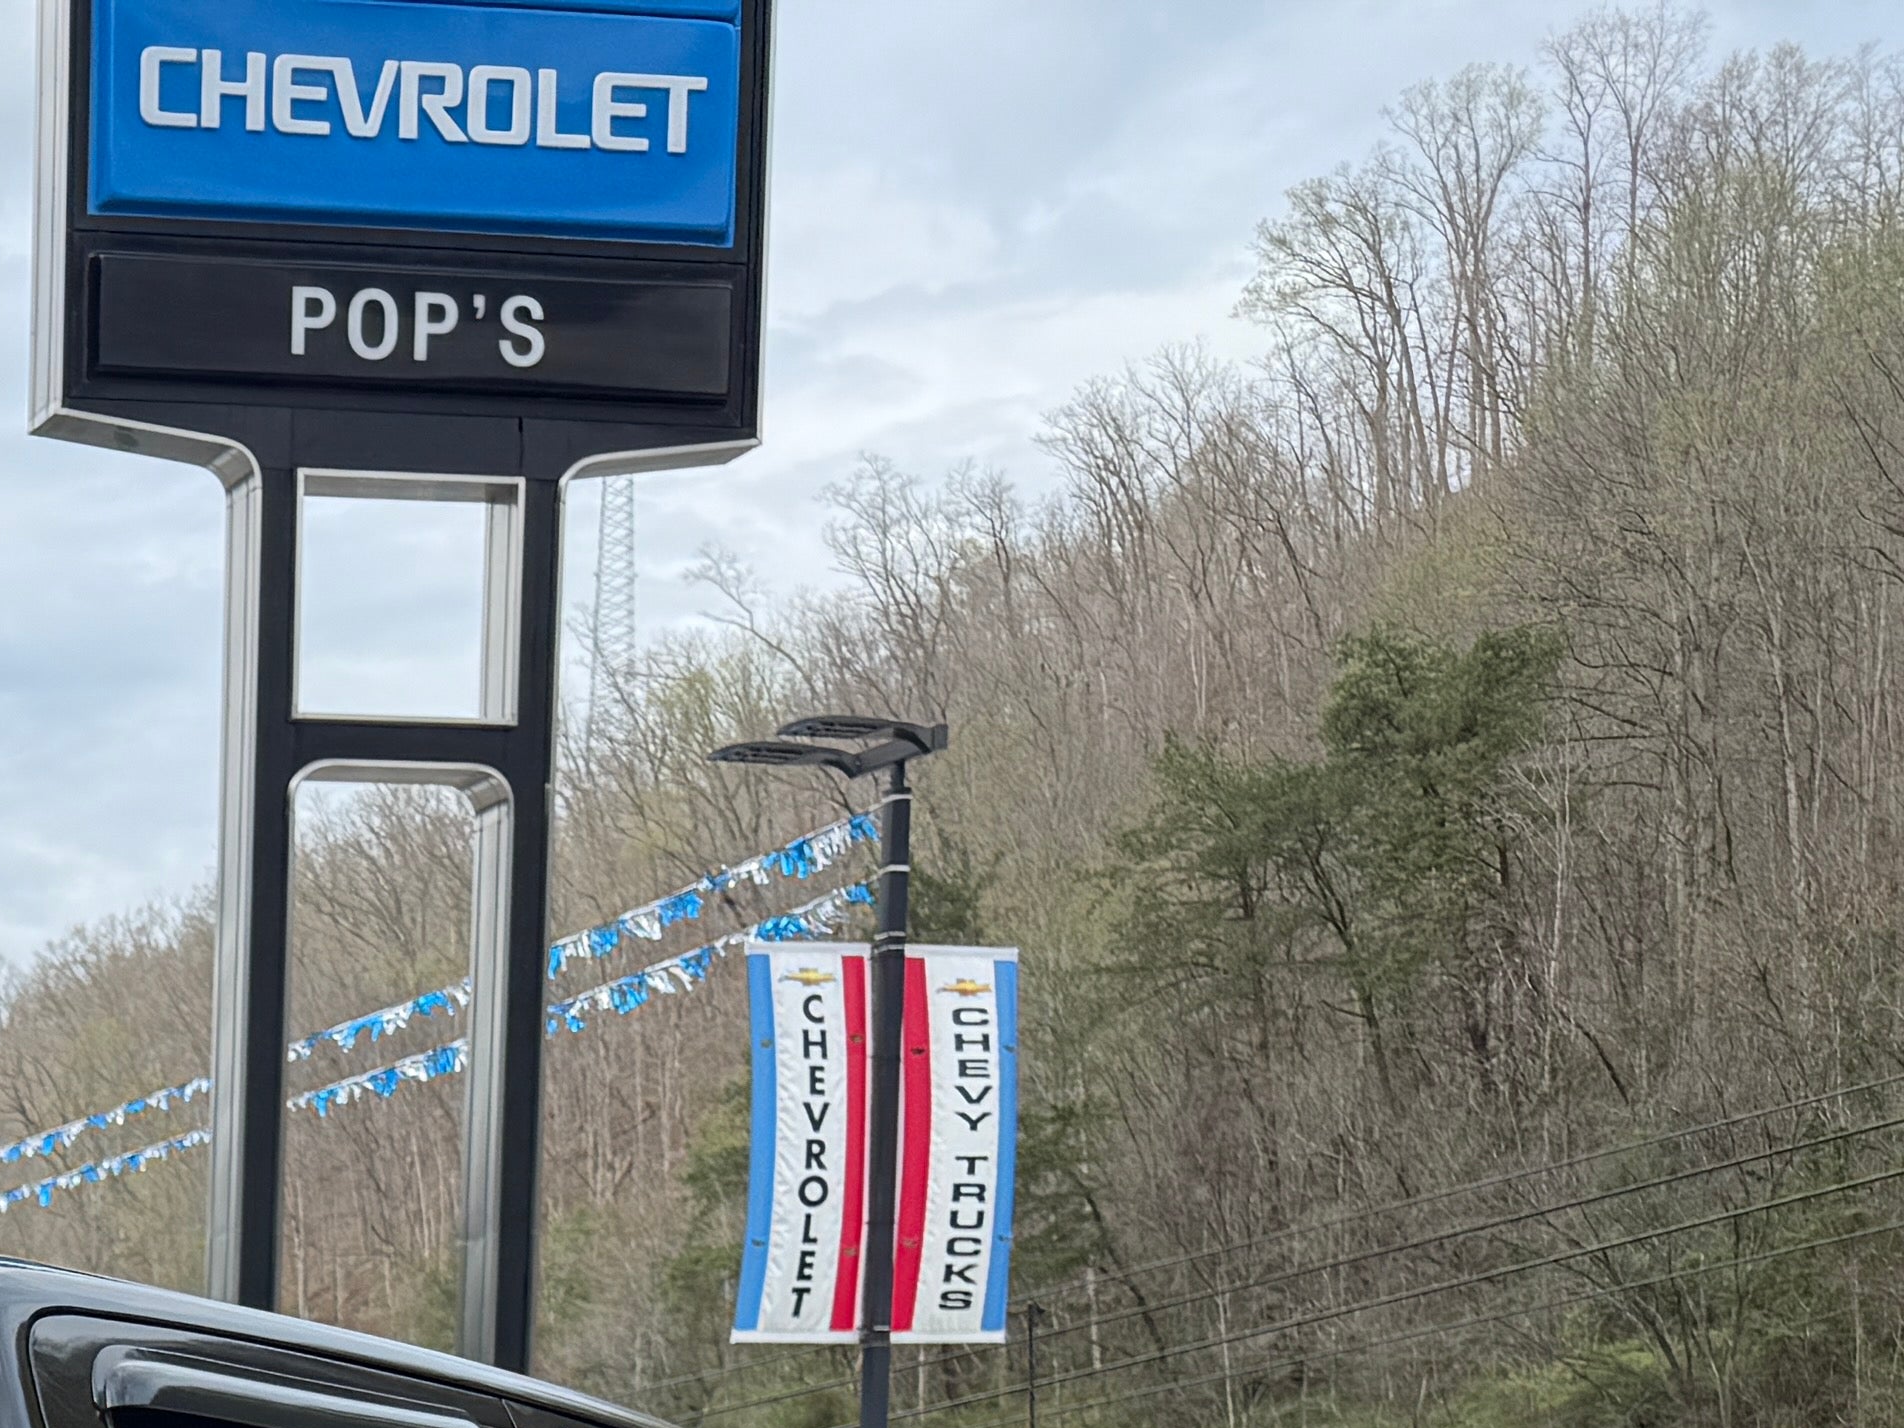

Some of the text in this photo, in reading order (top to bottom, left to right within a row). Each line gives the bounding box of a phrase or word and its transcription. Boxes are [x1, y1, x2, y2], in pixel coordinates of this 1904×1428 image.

[138, 45, 708, 155] CHEVROLET
[290, 285, 547, 368] POP'S
[791, 994, 830, 1319] CHEVROLET
[938, 1007, 993, 1311] CHEVY TRUCKS
